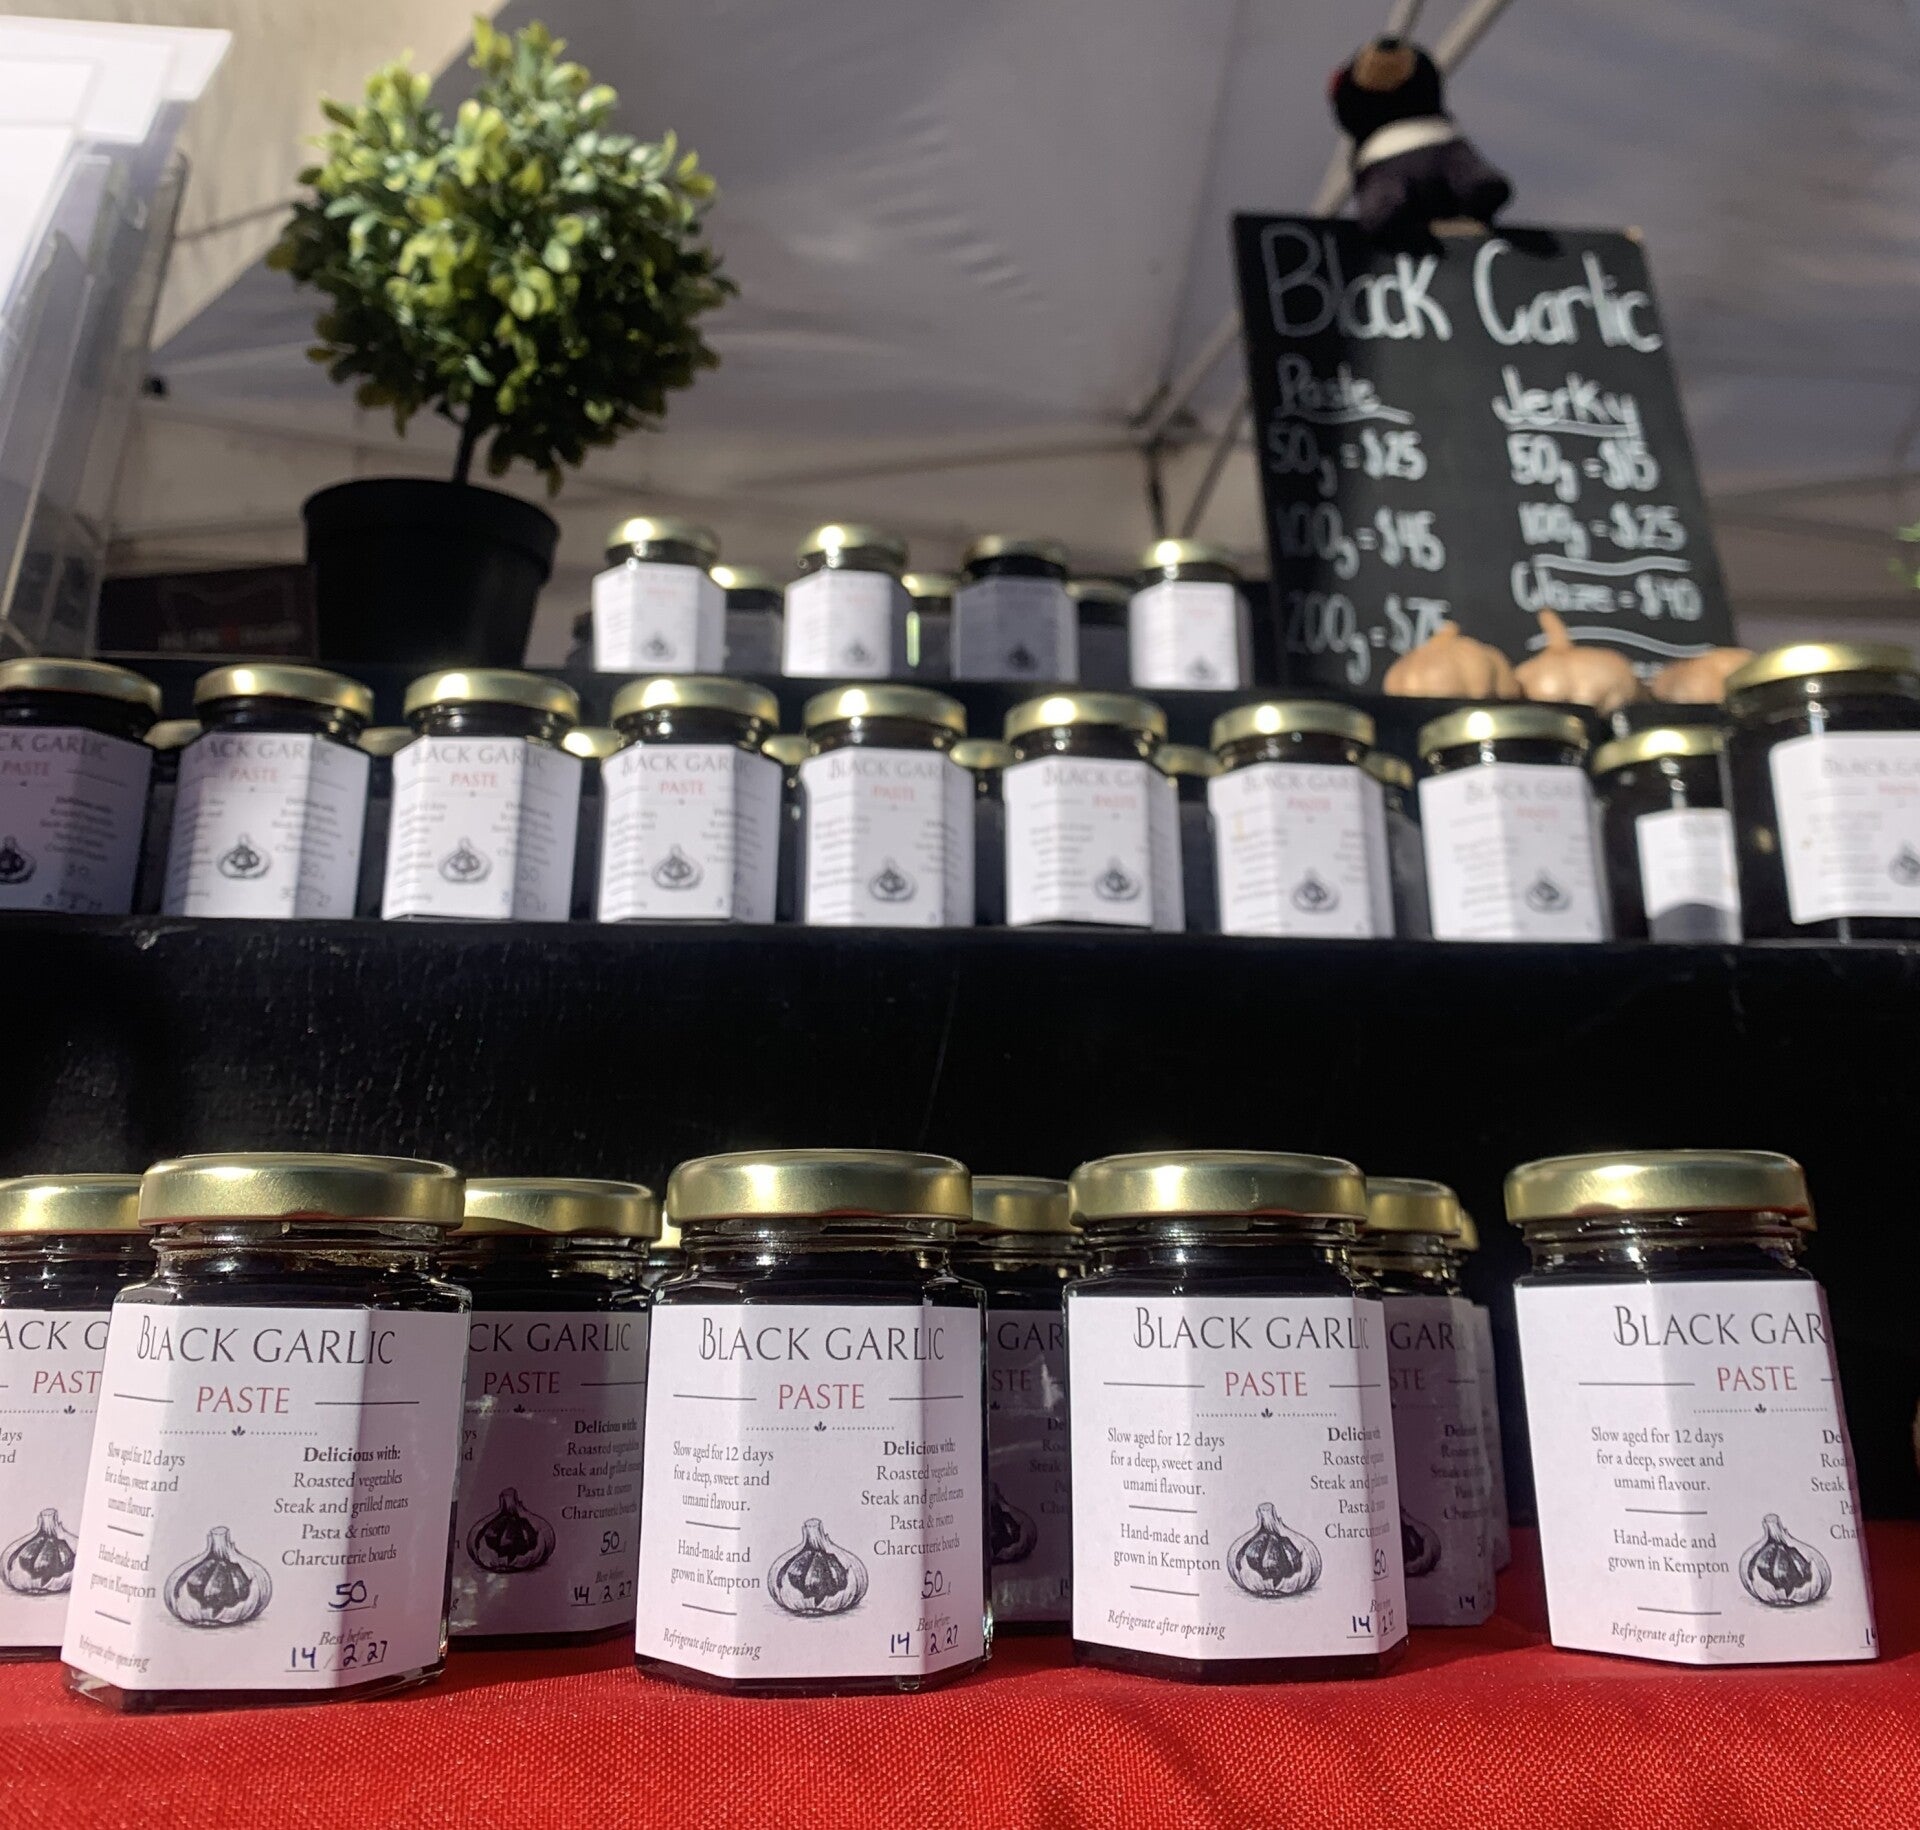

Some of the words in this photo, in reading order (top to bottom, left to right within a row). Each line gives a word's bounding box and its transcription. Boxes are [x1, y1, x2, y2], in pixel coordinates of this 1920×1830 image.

[0, 1320, 71, 1350] ACK
[527, 1323, 631, 1352] GARLIC
[997, 1322, 1064, 1350] GAR
[1266, 1317, 1369, 1350] GARLIC
[1390, 1322, 1455, 1350] GAR
[1751, 1313, 1829, 1344] GAR
[253, 1328, 395, 1364] GARLIC
[826, 1327, 945, 1360] GARLIC
[33, 1371, 101, 1394] PAST
[484, 1371, 561, 1394] PASTE
[991, 1370, 1032, 1392] STE
[1225, 1372, 1308, 1397] PASTE
[1718, 1366, 1797, 1391] PASTE
[196, 1386, 290, 1413] PASTE
[778, 1384, 865, 1410] PASTE
[1108, 1428, 1131, 1444] Slow
[1134, 1431, 1155, 1449] aged
[1157, 1430, 1172, 1446] for
[1176, 1432, 1191, 1446] 12
[1194, 1432, 1225, 1452] days
[1592, 1426, 1619, 1442] Slow
[1622, 1429, 1648, 1448] aged
[1651, 1428, 1669, 1443] for
[1675, 1429, 1692, 1444] 12
[1695, 1430, 1724, 1448] days
[154, 1450, 185, 1471] days
[303, 1446, 374, 1463] Delicious
[376, 1445, 401, 1460] with:
[673, 1441, 692, 1457] Slow
[693, 1444, 710, 1465] aged
[726, 1447, 739, 1461] 12
[742, 1446, 774, 1467] days
[1110, 1451, 1125, 1466] for
[1134, 1454, 1160, 1473] deep,
[1162, 1460, 1193, 1471] sweet
[1197, 1456, 1222, 1471] and
[1597, 1449, 1613, 1466] for
[1625, 1451, 1656, 1471] deep,
[1659, 1455, 1695, 1467] sweet
[1699, 1451, 1724, 1467] and
[294, 1472, 355, 1488] Roasted
[359, 1470, 402, 1491] vegetables
[552, 1463, 586, 1478] Steak
[714, 1474, 739, 1486] sweet
[743, 1471, 770, 1486] and
[876, 1465, 929, 1481] Roasted
[151, 1476, 179, 1492] and
[1123, 1479, 1158, 1493] umami
[1160, 1478, 1206, 1496] flavour.
[1310, 1475, 1345, 1490] Steak
[1349, 1474, 1369, 1489] and
[1614, 1476, 1655, 1490] umami
[1658, 1476, 1710, 1491] flavour.
[1811, 1477, 1845, 1492] Steak
[274, 1499, 314, 1514] Steak
[319, 1498, 348, 1514] and
[352, 1496, 383, 1518] grilled
[385, 1497, 408, 1510] meats
[710, 1493, 750, 1511] flavour.
[861, 1490, 899, 1506] Steak
[903, 1490, 927, 1505] and
[1339, 1499, 1370, 1514] Pasta
[302, 1524, 340, 1540] Pasta
[345, 1525, 358, 1538] &
[361, 1523, 390, 1538] risotto
[891, 1514, 924, 1530] Pasta
[1121, 1523, 1181, 1544] Hand-made
[1183, 1529, 1209, 1545] and
[1613, 1529, 1687, 1548] Hand-made
[1691, 1533, 1716, 1548] and
[282, 1549, 366, 1566] Charcuterie
[369, 1545, 397, 1562] boards
[678, 1539, 723, 1561] Hand-made
[726, 1547, 751, 1563] and
[1114, 1550, 1145, 1567] grown
[1148, 1552, 1158, 1566] in
[1161, 1552, 1220, 1575] Kempton
[1608, 1556, 1645, 1572] grown
[1648, 1557, 1660, 1571] in
[1664, 1557, 1729, 1578] Kempton
[706, 1572, 760, 1595] Kempton
[1108, 1609, 1155, 1630] Refrigerate
[1156, 1617, 1179, 1636] after
[1181, 1624, 1225, 1640] opening
[1353, 1615, 1371, 1633] 14
[1612, 1622, 1666, 1641] Refrigerate
[1669, 1628, 1697, 1645] after
[1700, 1630, 1745, 1648] opening
[718, 1643, 761, 1660] opening
[891, 1632, 911, 1655] 14
[291, 1647, 316, 1669] 14
